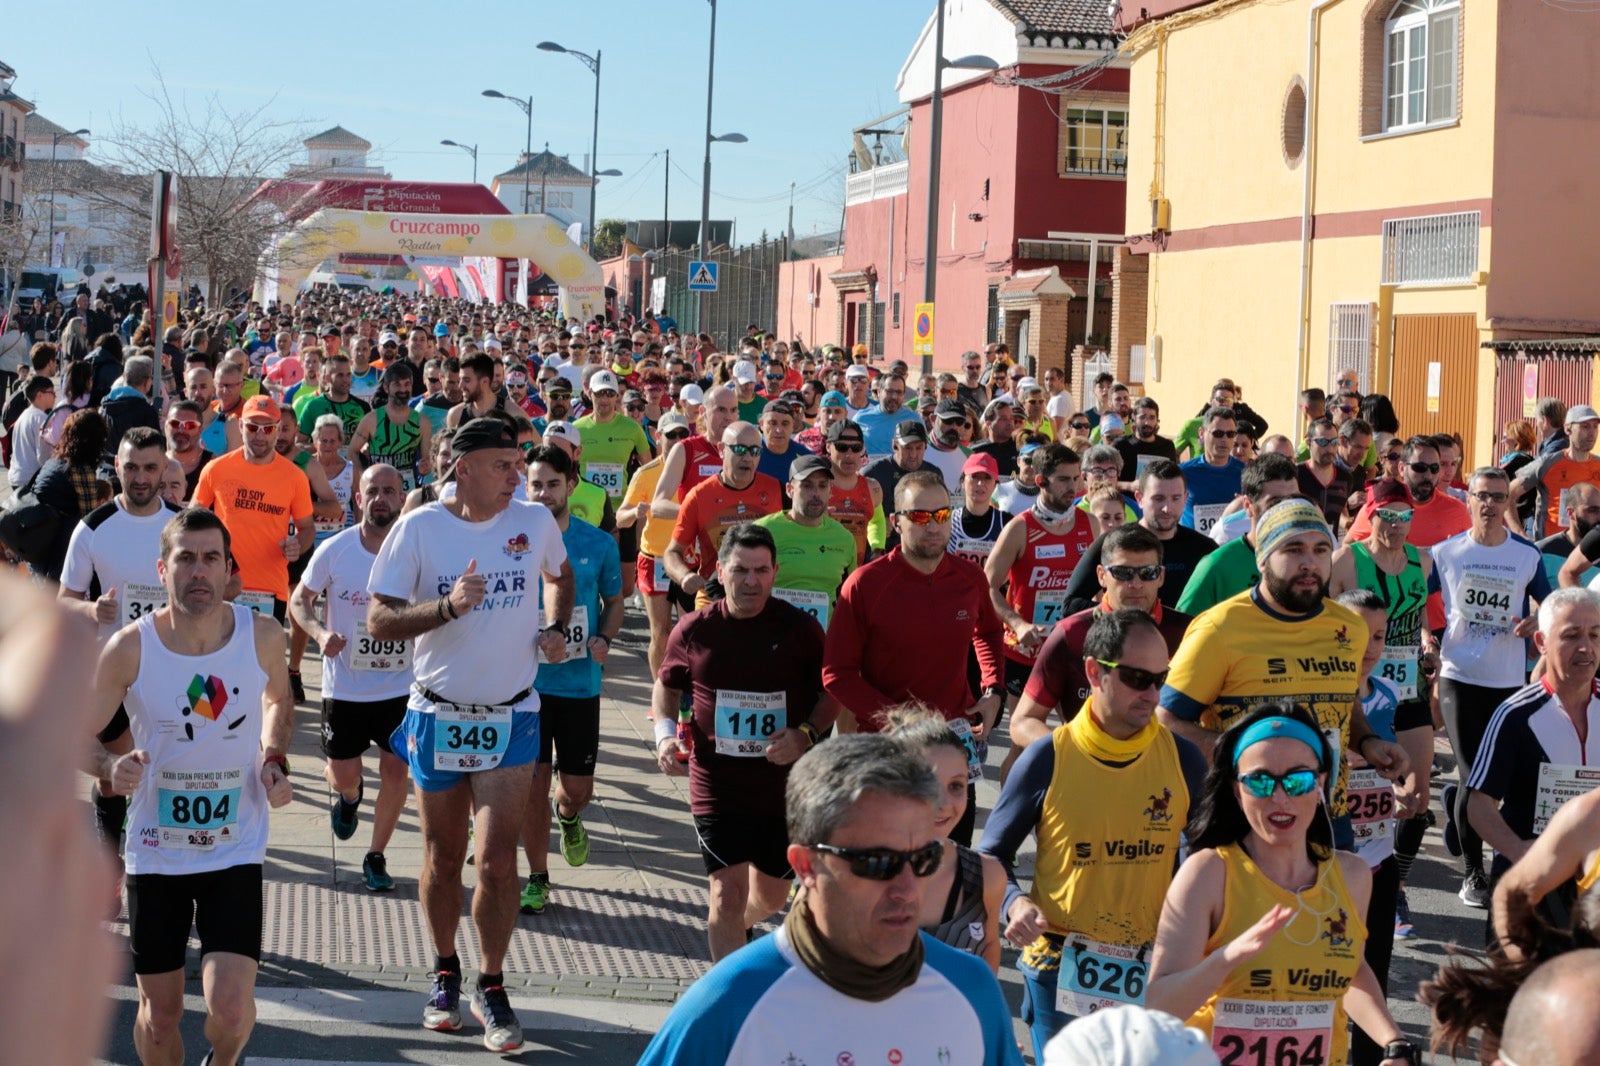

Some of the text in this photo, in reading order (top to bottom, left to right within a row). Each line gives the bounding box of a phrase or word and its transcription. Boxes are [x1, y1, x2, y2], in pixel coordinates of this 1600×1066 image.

[388, 189, 441, 201] Diputación
[388, 202, 441, 213] de Granada
[389, 218, 481, 237] Cruzcampo
[398, 239, 442, 252] Radler
[592, 473, 617, 487] 635
[237, 488, 265, 500] YO SOY
[235, 498, 256, 510] BEER
[1465, 589, 1510, 611] 3044
[358, 638, 406, 656] 3093
[1297, 656, 1357, 676] Vigilsa
[728, 711, 776, 737] 118
[447, 725, 498, 751] 349
[177, 772, 193, 781] GRAN
[193, 772, 215, 781] PREMIO
[215, 771, 223, 780] DE
[224, 770, 240, 779] FONDO
[185, 780, 219, 790] DIPUTACIÓN
[172, 794, 230, 825] 804
[1105, 840, 1166, 860] Vigilsa
[1078, 956, 1146, 999] 626
[1288, 968, 1352, 992] Vigilsa
[1223, 1003, 1329, 1016] XXXIII GRAN PREMIO DE FONDO
[1254, 1016, 1298, 1028] DIPUTACIÓN
[1219, 1034, 1324, 1066] 2164
